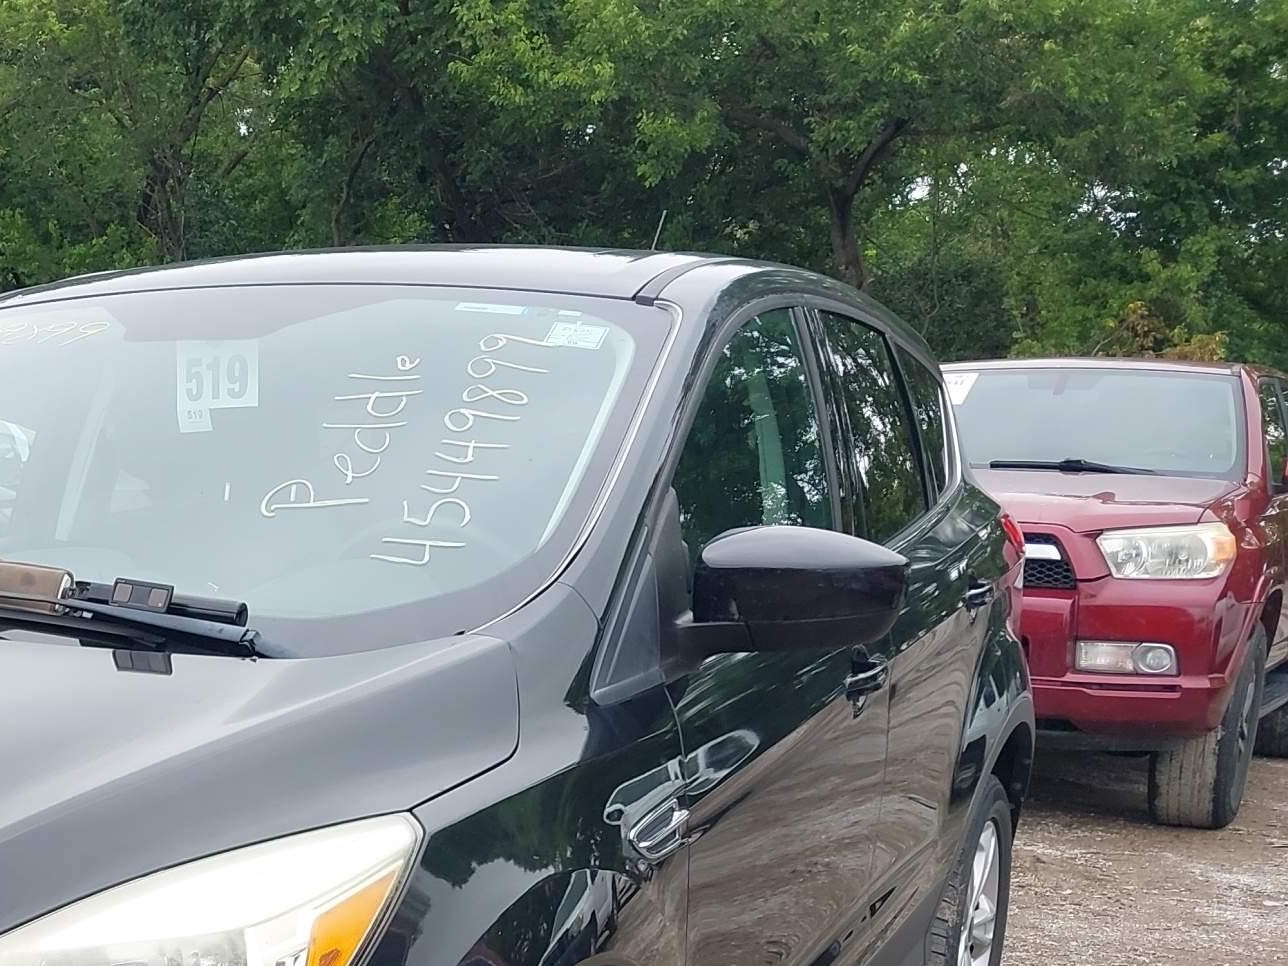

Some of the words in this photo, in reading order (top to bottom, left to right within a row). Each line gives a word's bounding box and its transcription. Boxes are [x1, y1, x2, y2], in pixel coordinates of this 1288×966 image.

[185, 354, 249, 402] 519
[261, 354, 424, 517] Peddle
[369, 333, 556, 566] 45449899
